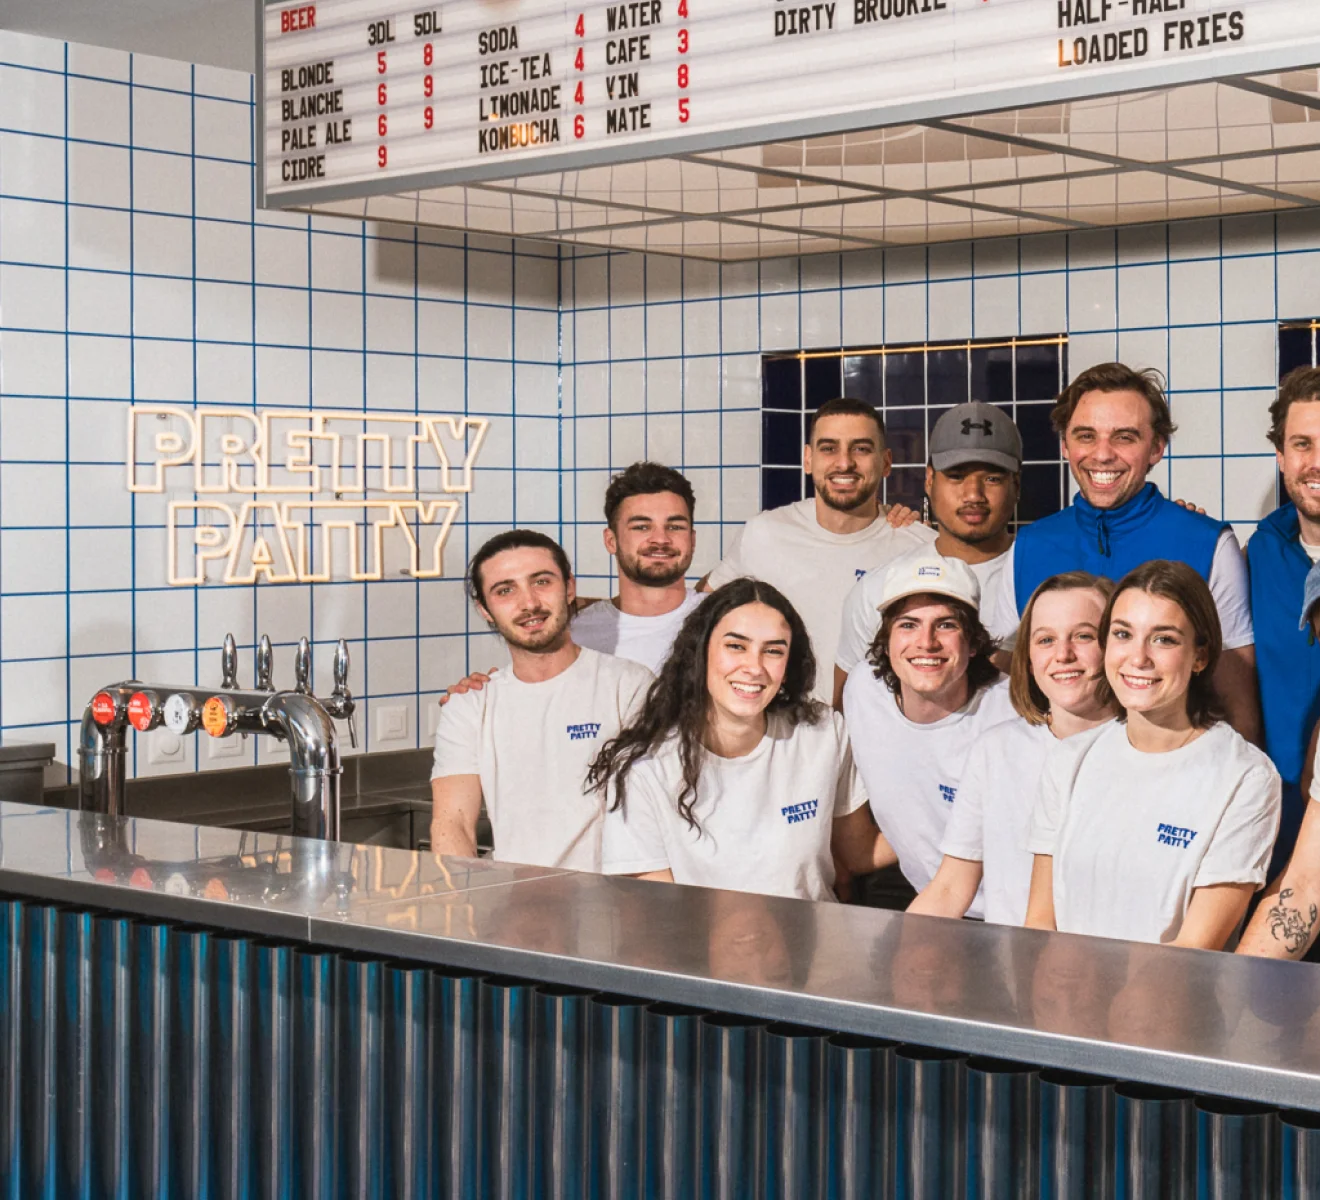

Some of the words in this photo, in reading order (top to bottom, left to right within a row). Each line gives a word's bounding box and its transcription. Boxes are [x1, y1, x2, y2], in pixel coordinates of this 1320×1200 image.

[281, 6, 316, 33] BEER
[367, 20, 395, 46] 3DL
[414, 11, 442, 37] 5DL
[478, 25, 518, 56] SODA
[574, 13, 584, 38] 4
[606, 0, 662, 32] WATER
[677, 0, 688, 19] 4
[774, 2, 835, 37] DIRTY
[605, 34, 651, 65] CAFE
[677, 28, 689, 54] 3
[1057, 28, 1148, 67] LOADED
[1163, 11, 1244, 51] FRIES
[281, 61, 334, 92] BLONDE
[377, 51, 387, 75] 5
[423, 43, 433, 66] 8
[480, 52, 551, 88] ICE-TEA
[574, 47, 584, 71] 4
[605, 72, 639, 101] VIN
[677, 63, 689, 89] 8
[281, 90, 343, 122] BLANCHE
[377, 83, 387, 106] 6
[423, 74, 433, 98] 9
[479, 84, 561, 122] LIMONADE
[574, 80, 584, 105] 4
[606, 103, 651, 134] MATE
[678, 98, 690, 123] 5
[281, 125, 316, 152] PALE
[325, 119, 352, 145] ALE
[378, 114, 387, 137] 6
[424, 106, 433, 129] 9
[479, 117, 560, 153] KOMBUCHA
[573, 114, 584, 139] 6
[281, 154, 325, 182] CIDRE
[378, 145, 387, 168] 9
[127, 405, 489, 493] PRETTY
[167, 500, 460, 586] PATTY
[566, 723, 601, 733] PRETTY
[570, 731, 597, 740] PATTY
[781, 798, 818, 816] PRETTY
[787, 808, 817, 824] PATTY
[1157, 822, 1198, 840] PRETTY
[1157, 833, 1191, 849] PATTY
